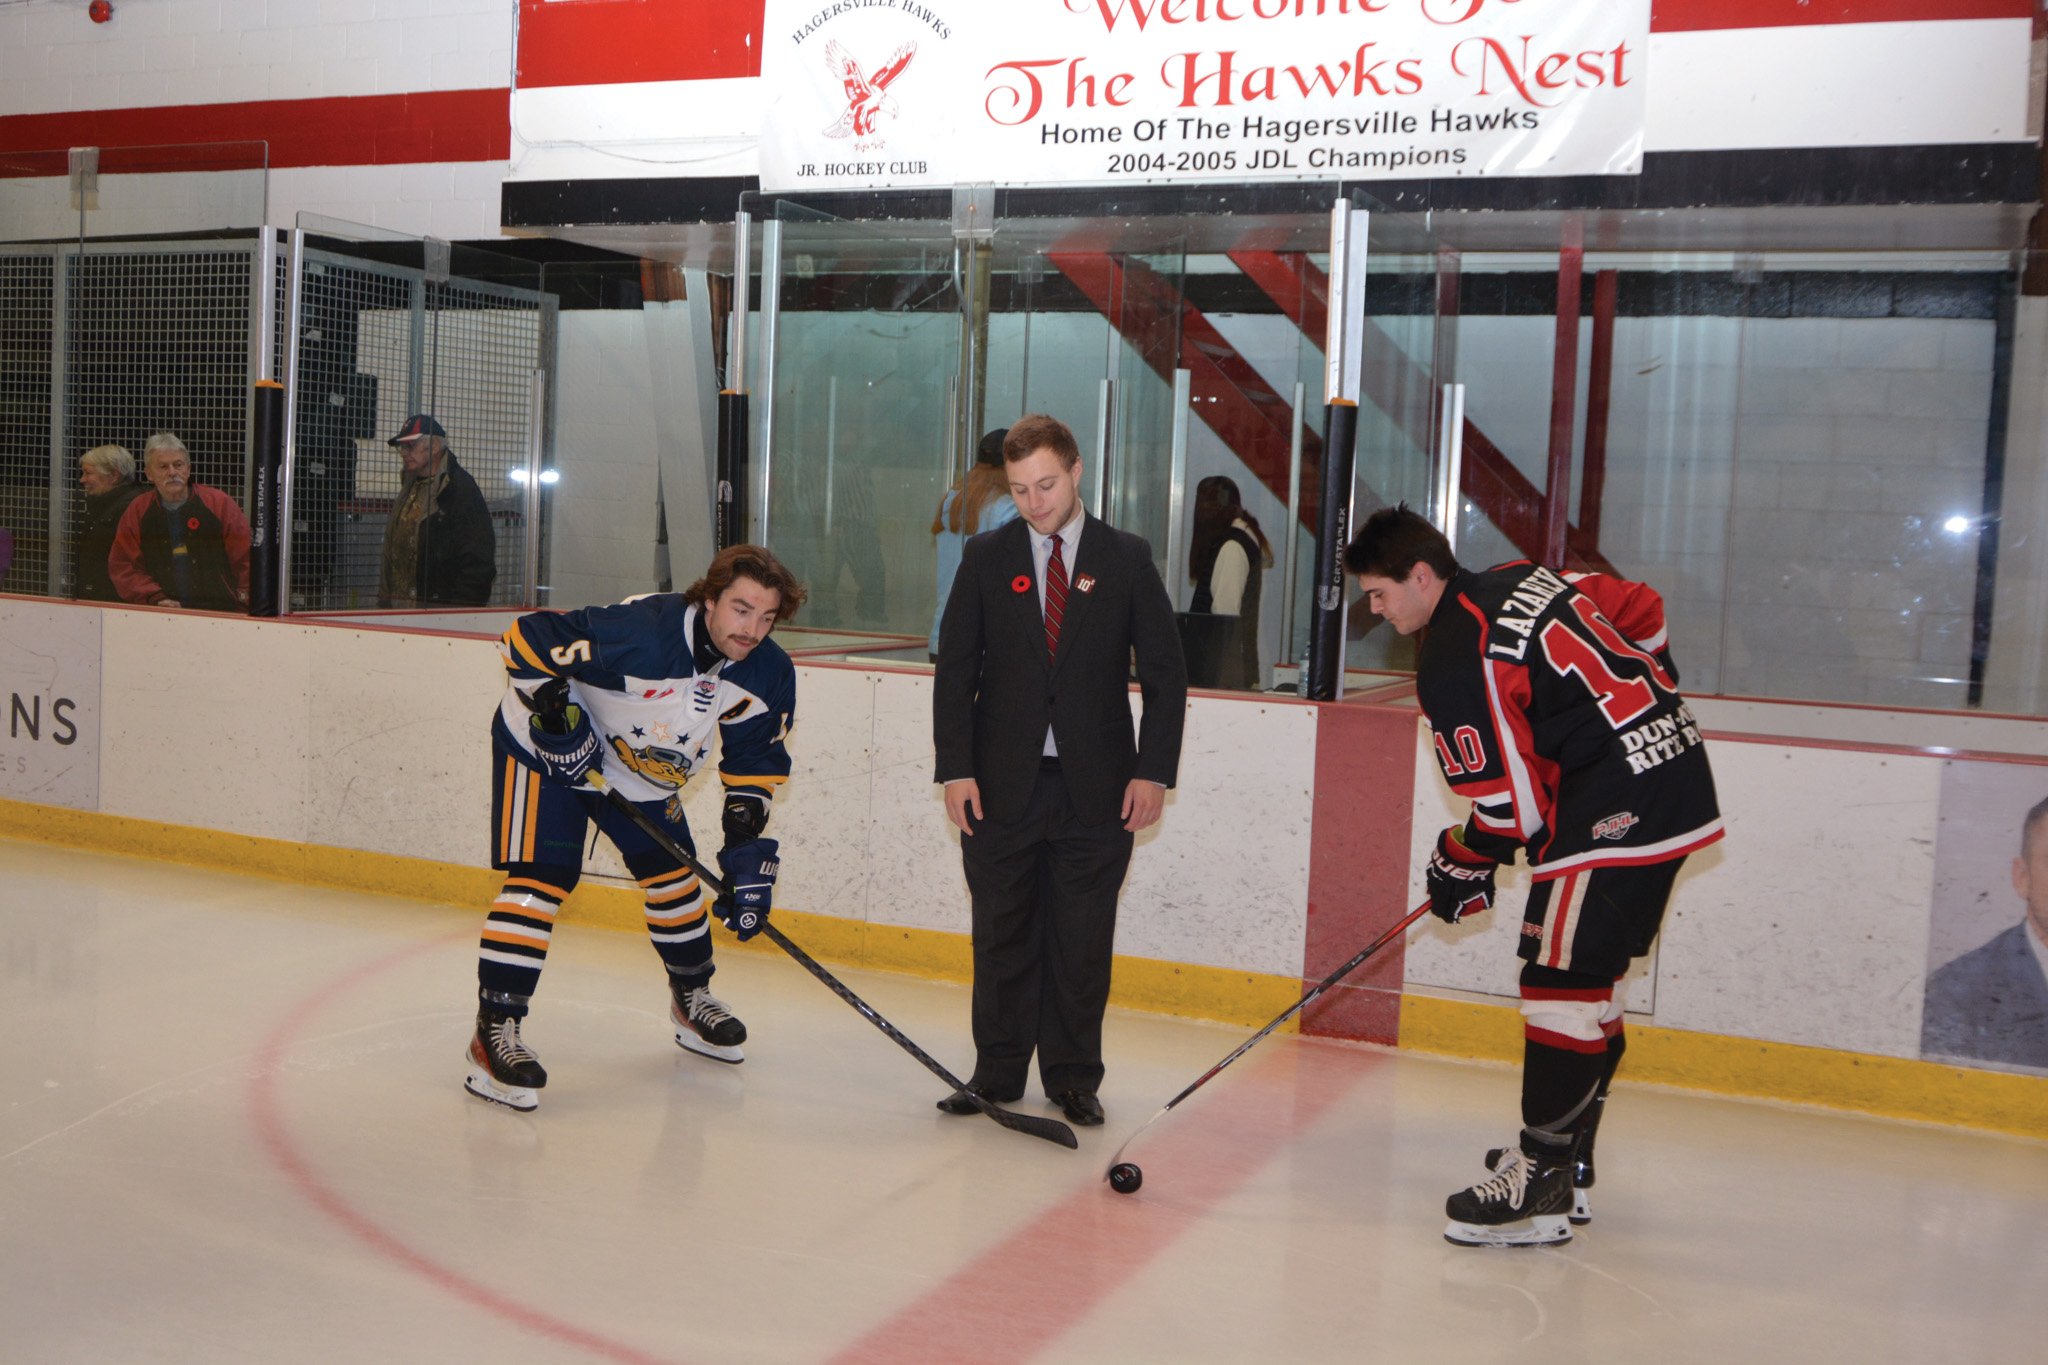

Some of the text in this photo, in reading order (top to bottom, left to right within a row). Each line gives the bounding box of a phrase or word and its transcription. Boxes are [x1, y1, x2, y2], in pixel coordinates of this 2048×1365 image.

[901, 0, 951, 40] HAWKS
[985, 35, 1632, 125] The Hawks Nest
[1041, 107, 1539, 144] Home Of The Hagersville Hawks
[797, 161, 927, 176] JR. HOCKEY CLUB
[1107, 146, 1467, 173] 2004-2005 JDL Champions
[257, 466, 265, 526] CRSTAPLEX
[1333, 507, 1346, 584] CRYSTAPLEX
[1539, 593, 1678, 730] 10
[0, 693, 77, 746] NS
[1434, 725, 1487, 776] 10
[1625, 733, 1685, 775] RITE
[1592, 814, 1640, 840] PJHL
